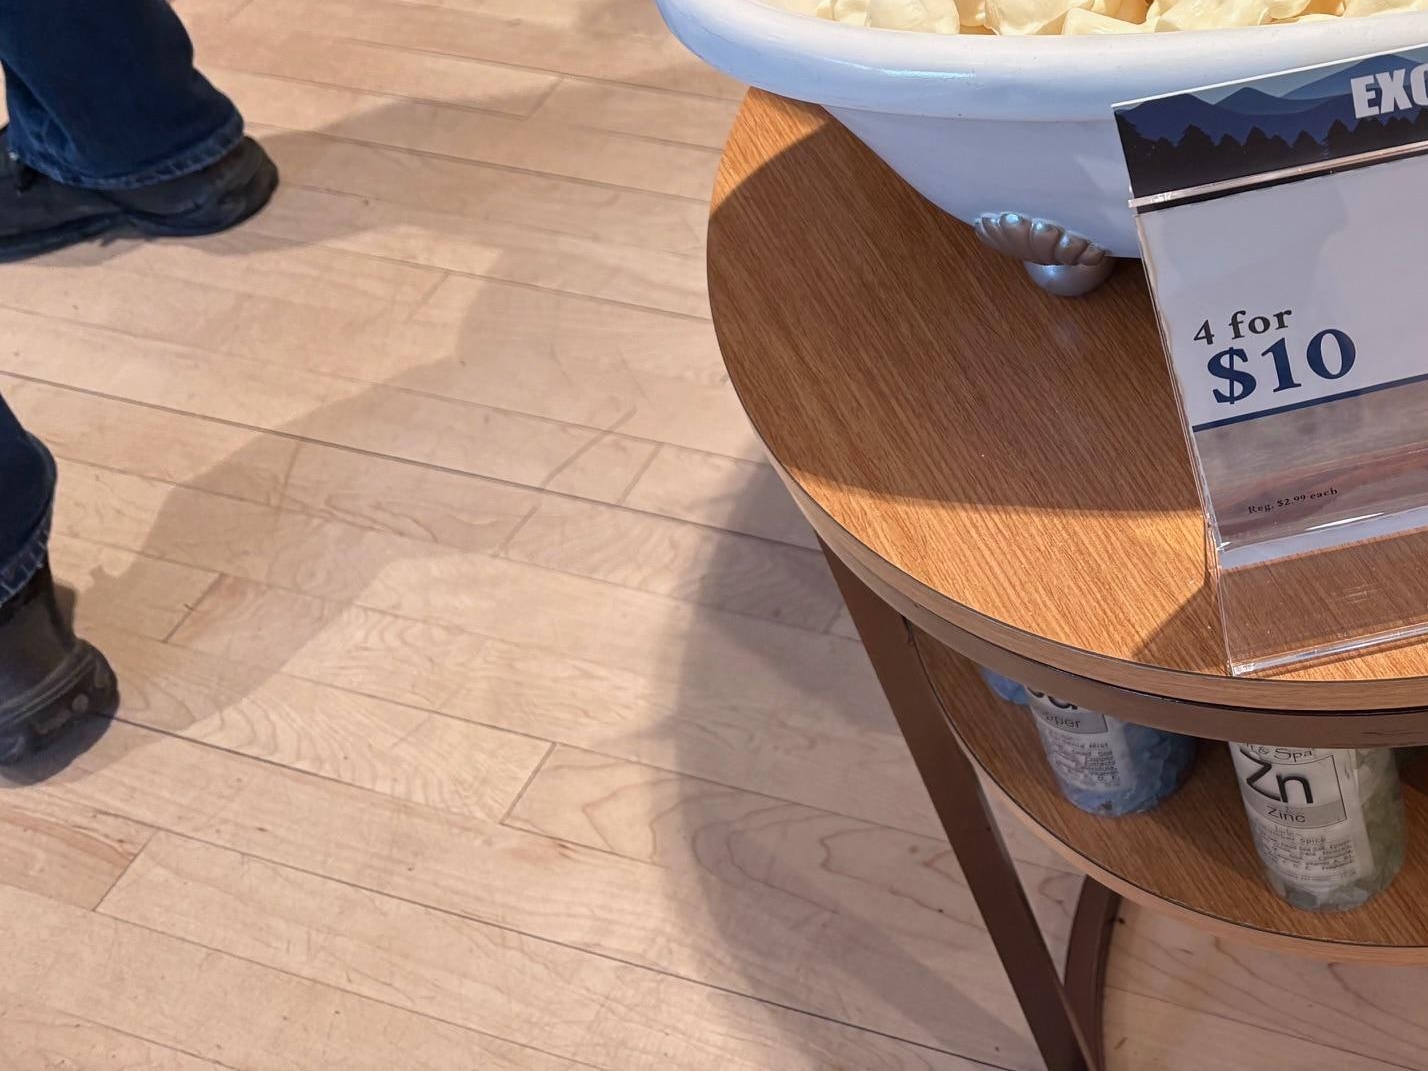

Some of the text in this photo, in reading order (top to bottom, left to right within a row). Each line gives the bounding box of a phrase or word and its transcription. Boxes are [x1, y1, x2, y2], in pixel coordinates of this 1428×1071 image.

[1193, 310, 1292, 345] 4 for
[1207, 328, 1356, 405] $10
[1248, 487, 1338, 514] Reg. $2.99 each
[1273, 747, 1313, 763] Spa
[1239, 747, 1314, 804] Zn
[1266, 805, 1306, 823] Zinc
